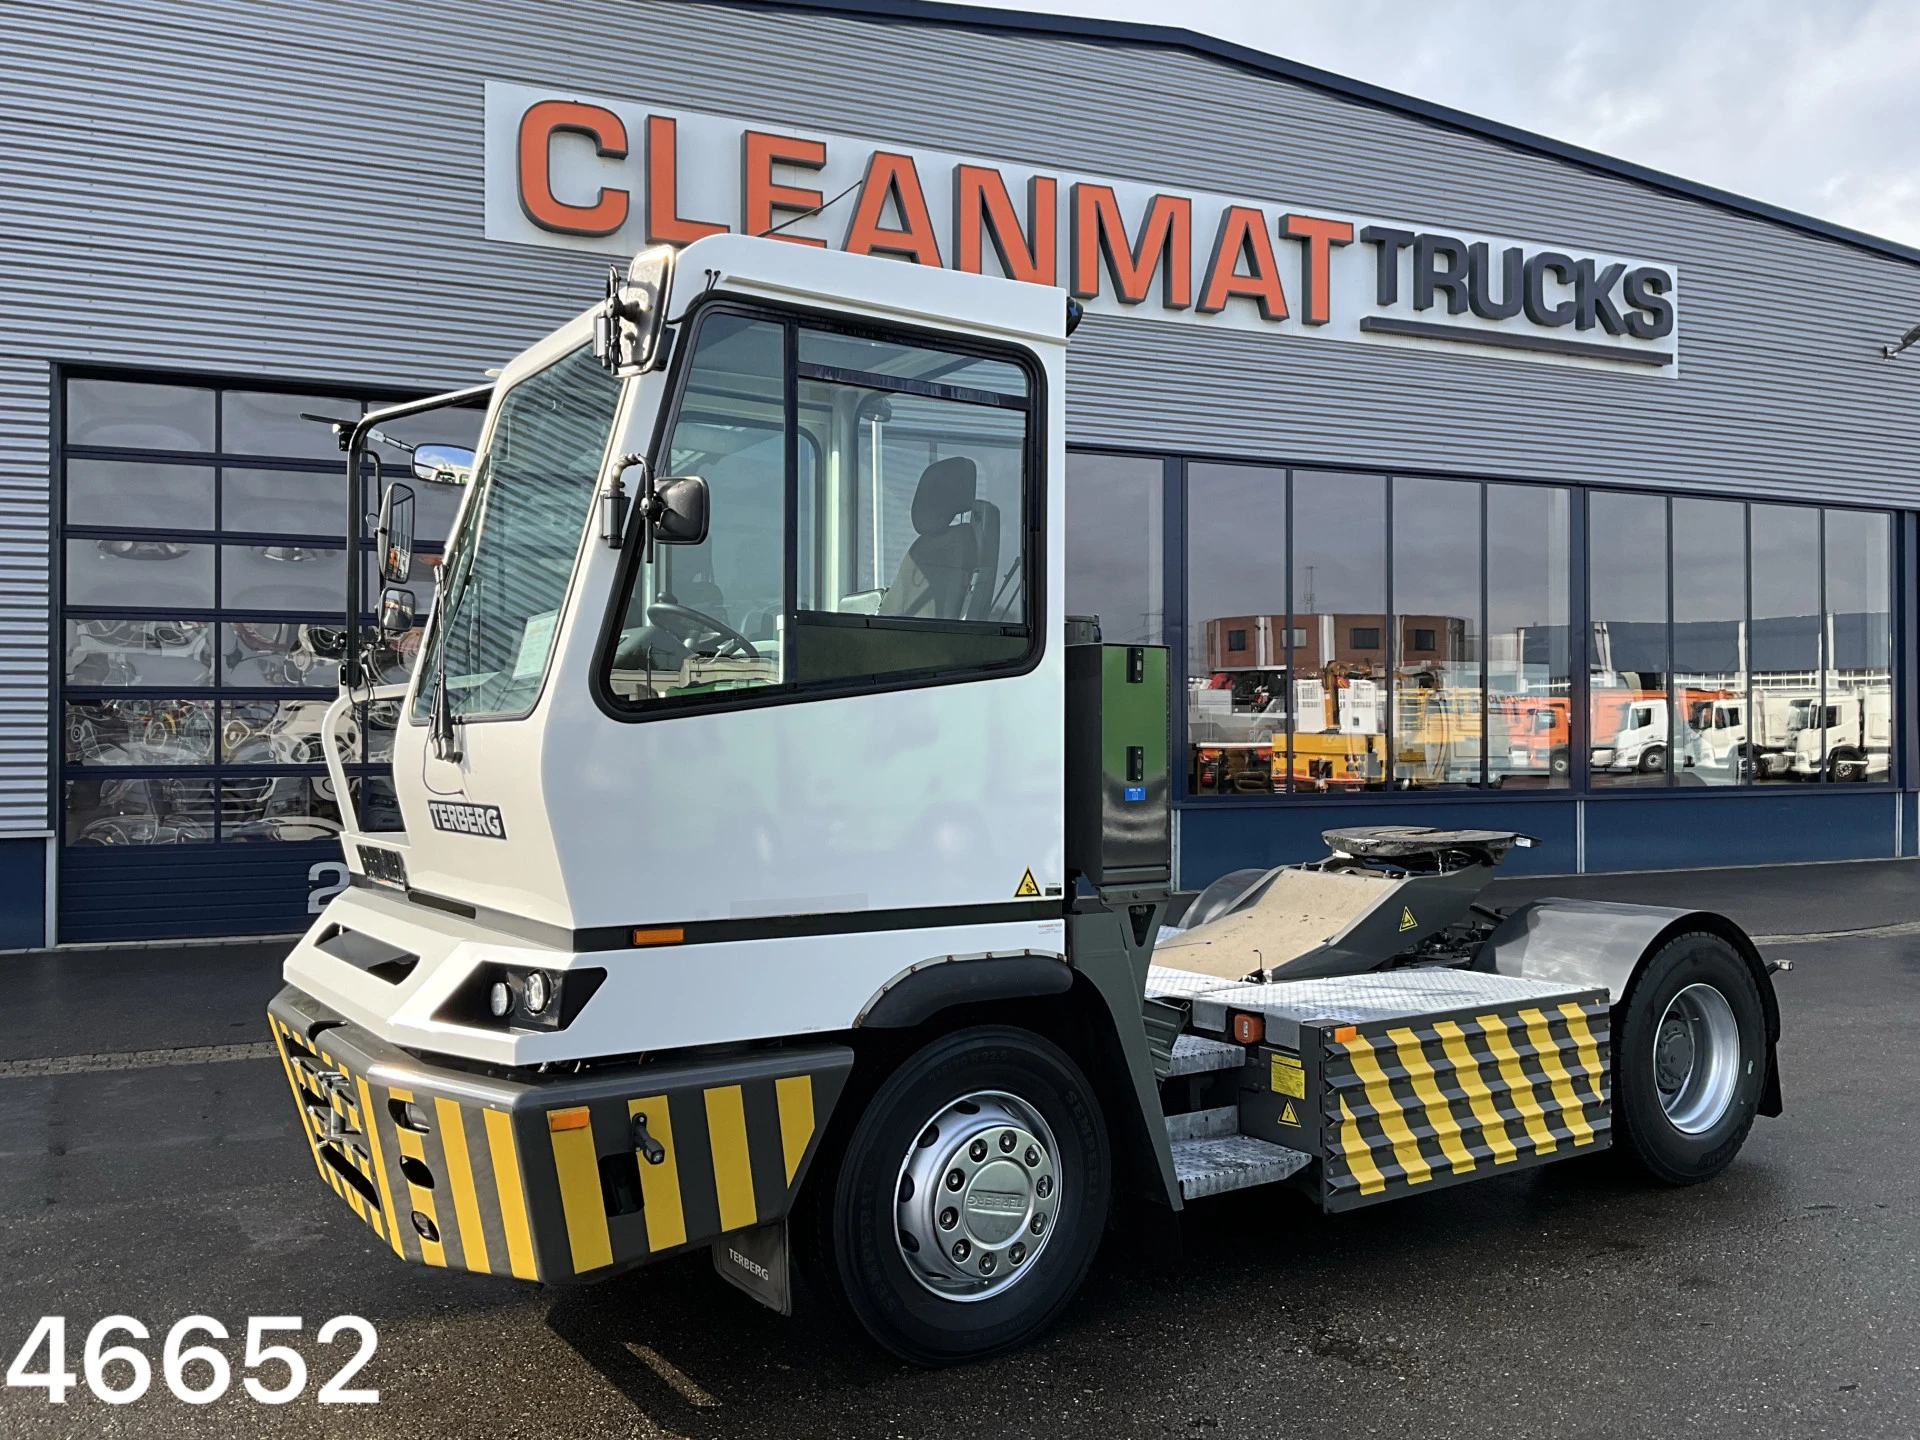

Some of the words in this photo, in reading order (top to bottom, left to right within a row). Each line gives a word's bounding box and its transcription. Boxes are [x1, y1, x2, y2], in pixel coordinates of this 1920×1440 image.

[517, 100, 1354, 325] CLEANMAT
[1360, 225, 1673, 340] TRUCKS
[429, 803, 501, 836] TERBERG
[308, 861, 350, 913] 2
[967, 1195, 1026, 1209] TERBERG
[728, 1247, 769, 1281] TERBERG
